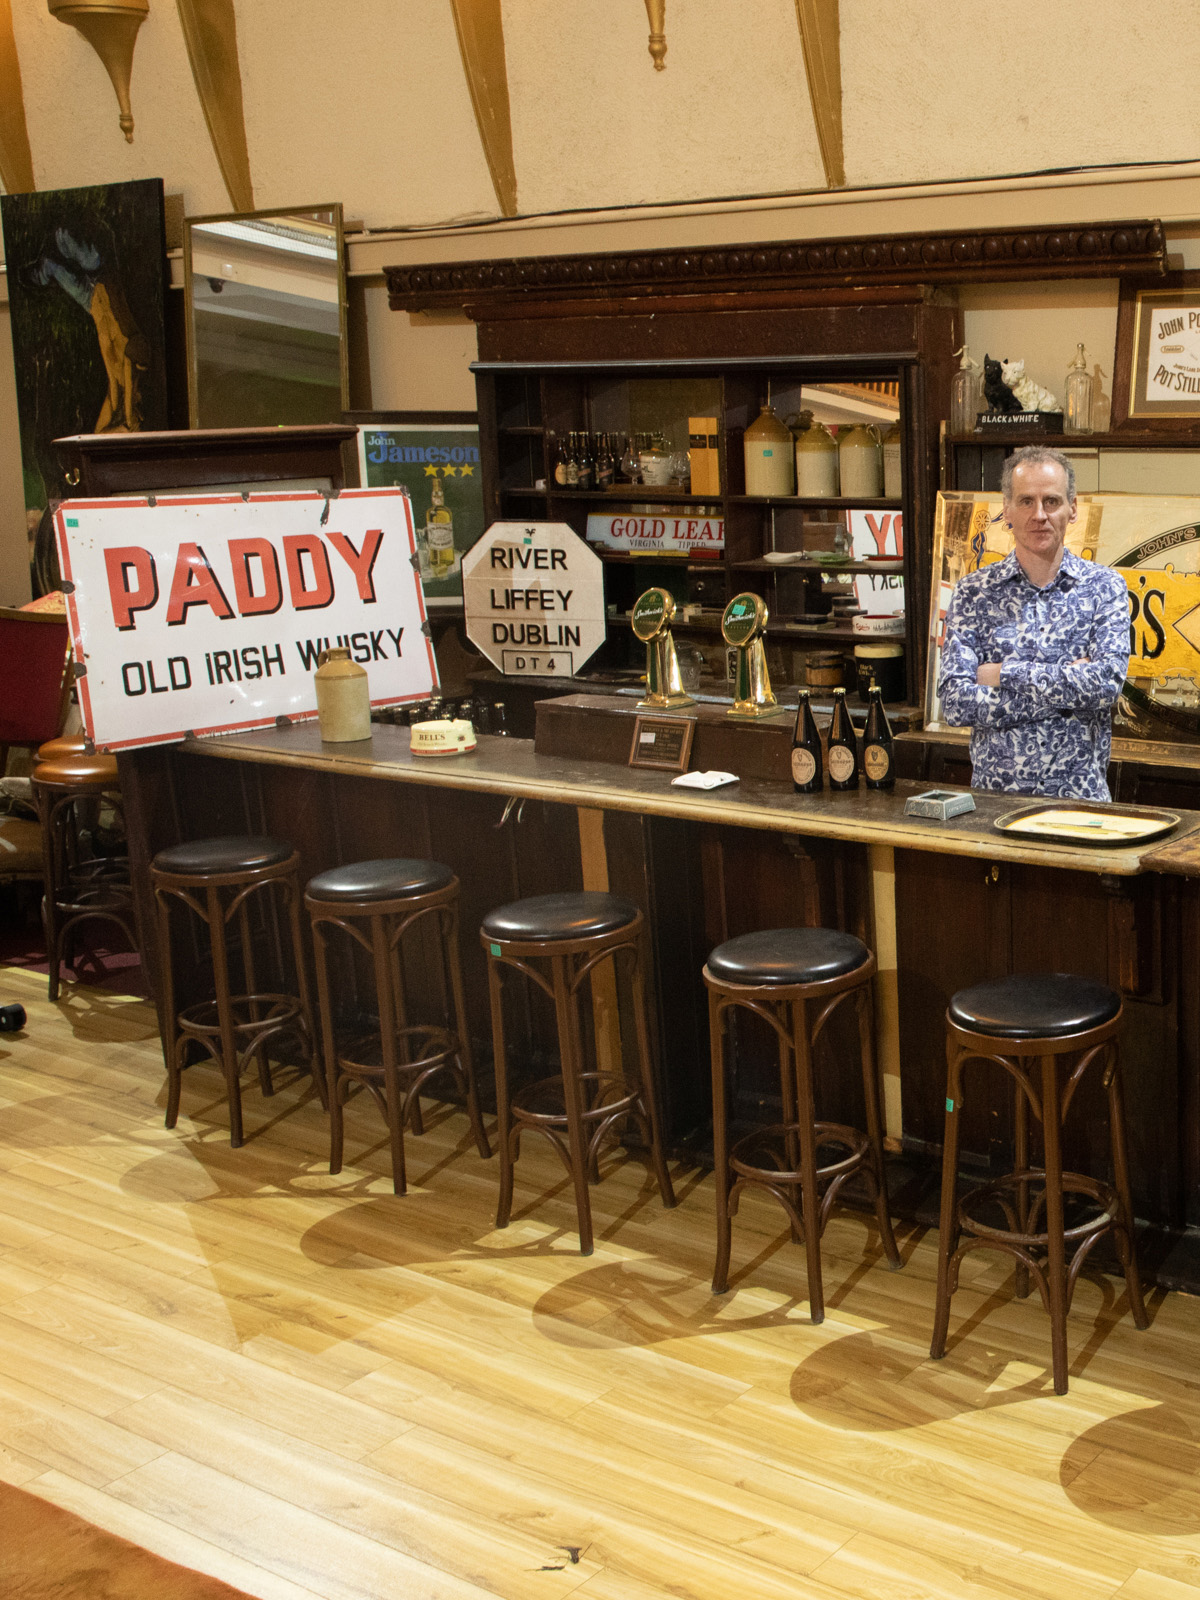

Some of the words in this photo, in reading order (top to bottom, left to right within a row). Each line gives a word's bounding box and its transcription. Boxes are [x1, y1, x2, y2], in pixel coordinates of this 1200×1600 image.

[1157, 316, 1185, 340] JOHN
[1153, 364, 1177, 389] POT
[981, 415, 1007, 423] BLACK
[1012, 414, 1040, 423] WHITE
[368, 435, 396, 446] John
[368, 432, 480, 464] Jameson
[610, 518, 666, 539] GOLD
[629, 539, 665, 548] VIRGINIA
[1137, 527, 1197, 560] JOHN'S
[490, 547, 568, 571] RIVER
[103, 529, 384, 632] PADDY
[490, 588, 573, 611] LIFFEY
[492, 622, 581, 647] DUBLIN
[121, 655, 192, 697] OLD
[205, 643, 286, 686] IRISH
[419, 733, 446, 741] BELL'S
